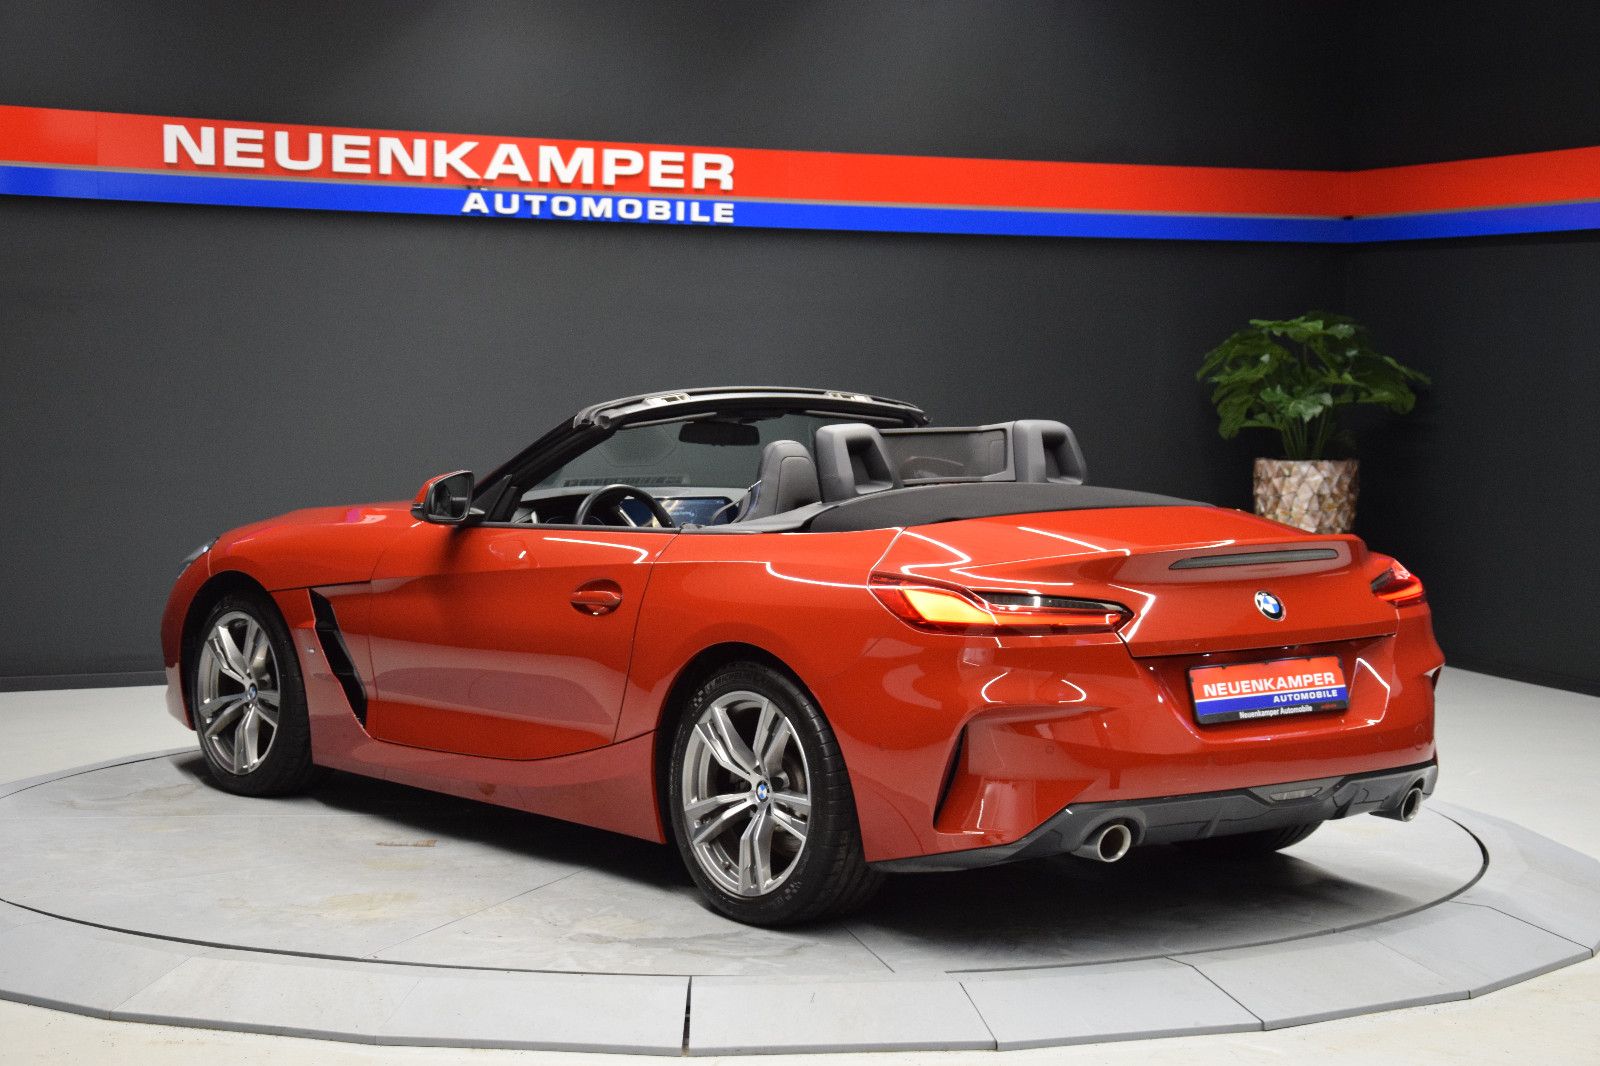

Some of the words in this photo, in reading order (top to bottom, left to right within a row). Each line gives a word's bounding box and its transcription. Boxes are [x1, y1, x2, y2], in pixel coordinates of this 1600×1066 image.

[163, 124, 735, 190] NEUENKAMPER
[461, 192, 735, 223] AUTOMOBILE
[1203, 672, 1336, 697] NEUENKAMPER
[1273, 690, 1338, 703] AUTOMOBILE
[1239, 708, 1280, 719] Neuenkamper
[1280, 705, 1313, 714] Automobile
